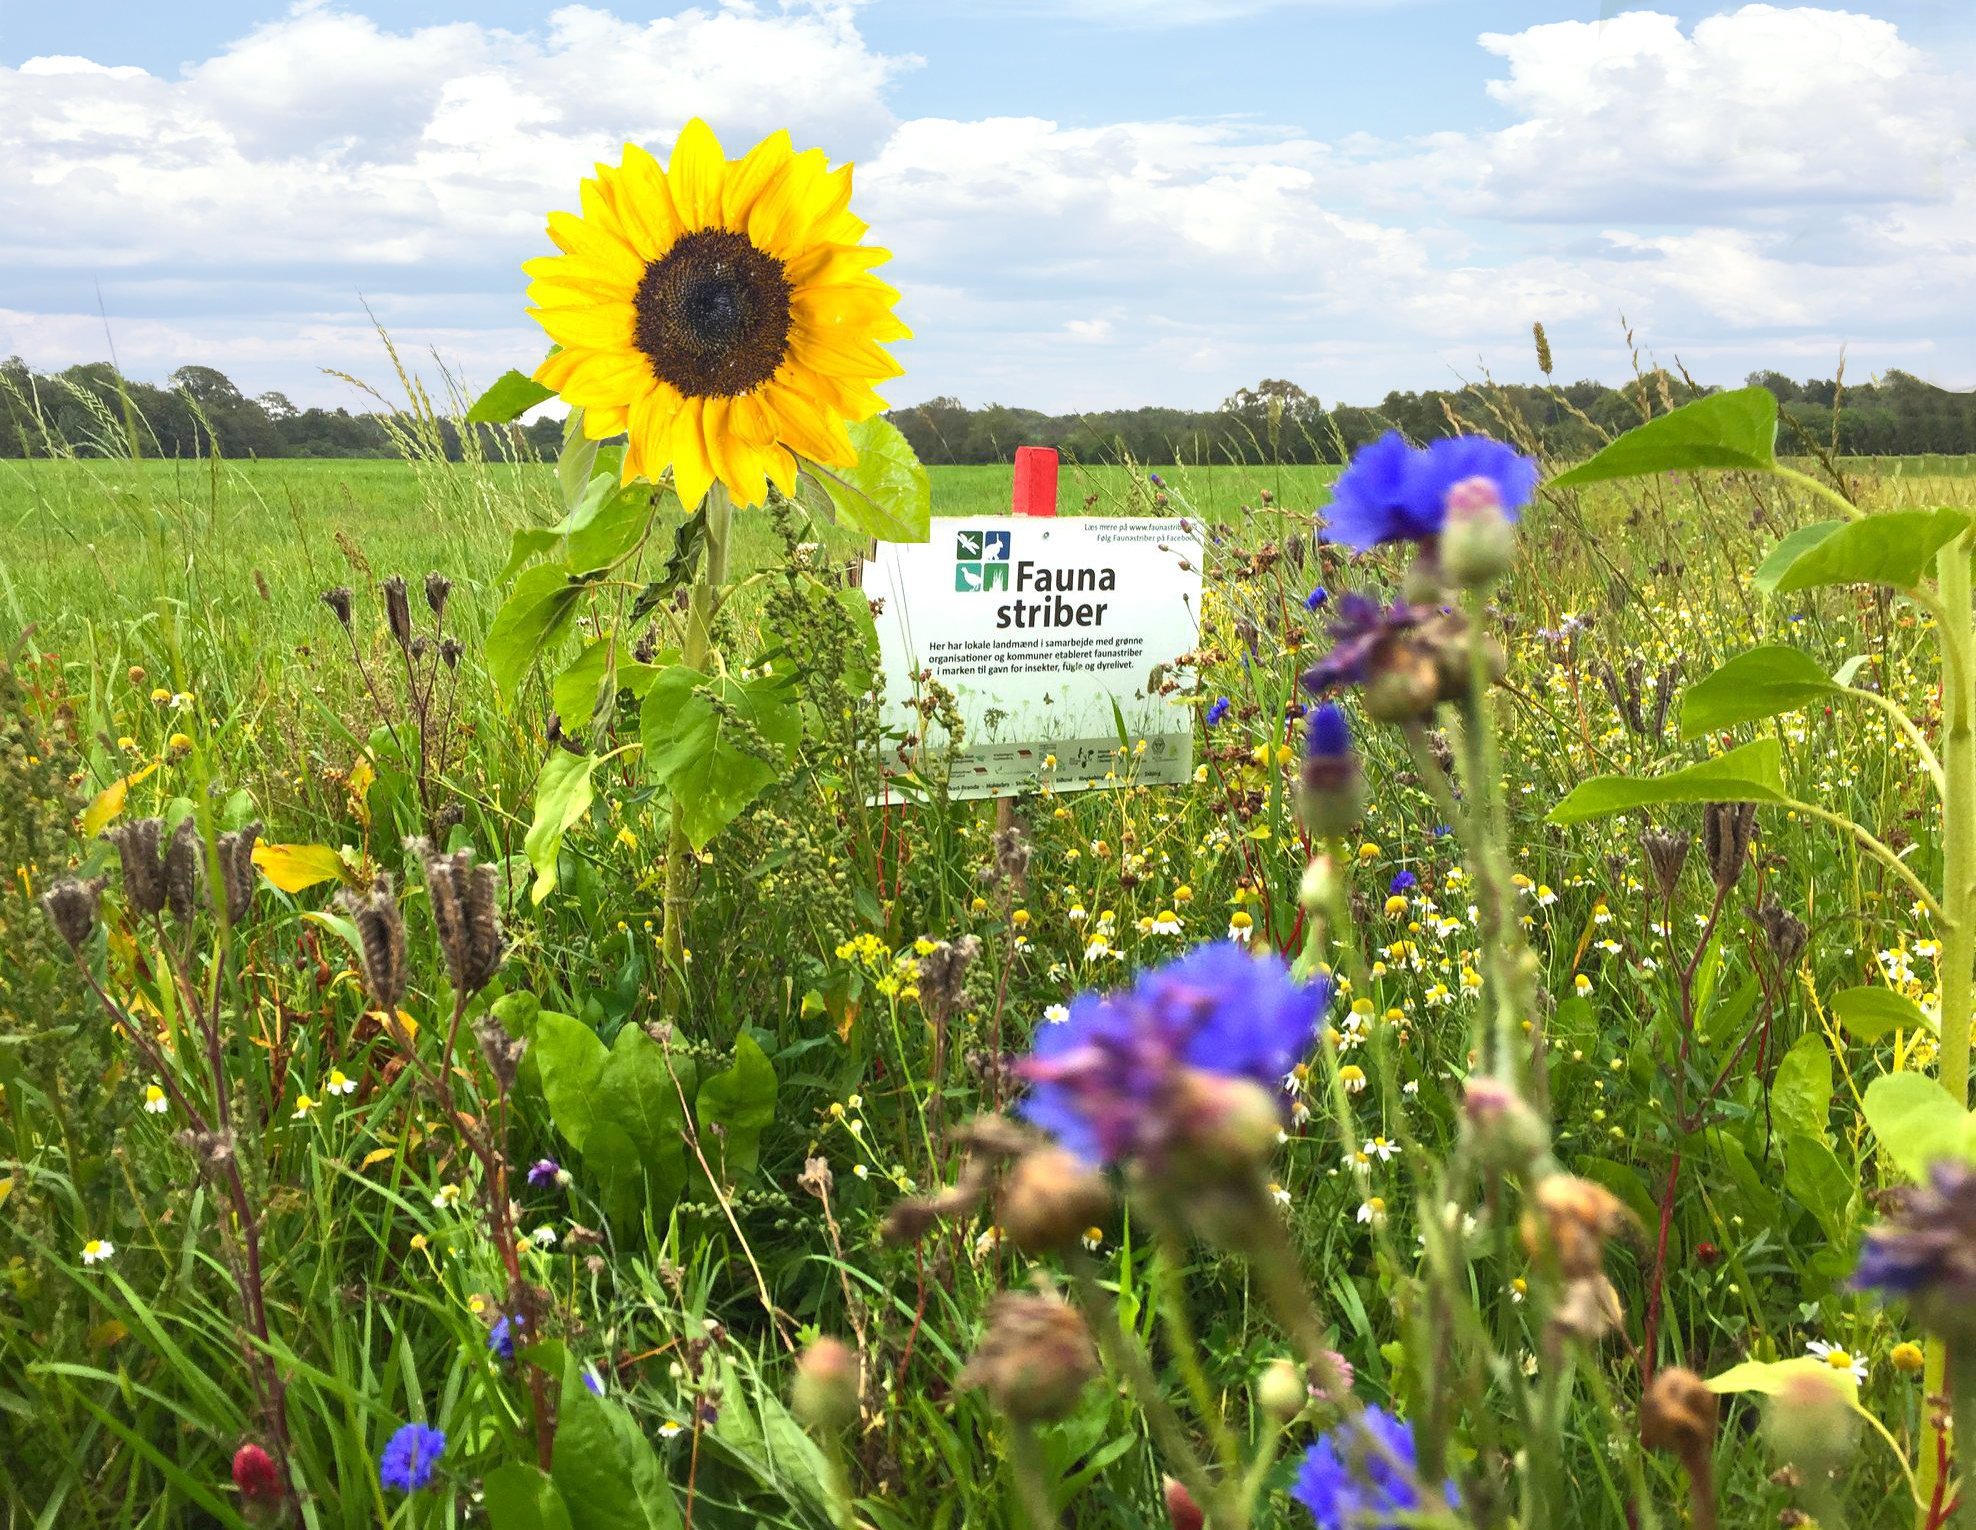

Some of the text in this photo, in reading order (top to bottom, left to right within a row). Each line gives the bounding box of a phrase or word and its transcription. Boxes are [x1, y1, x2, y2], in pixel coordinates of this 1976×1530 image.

[1084, 523, 1098, 531] Læs
[1119, 523, 1128, 532] på
[1097, 534, 1111, 543] Følg
[1113, 534, 1155, 542] Faunastriber
[1156, 534, 1165, 543] på
[1017, 561, 1116, 592] Fauna
[996, 595, 1108, 628] striber
[929, 641, 945, 651] Her
[947, 641, 962, 650] har
[964, 640, 991, 650] lokale
[992, 639, 1039, 649] landmænd
[1045, 637, 1094, 649] samarbejde
[1095, 637, 1114, 646] med
[1115, 637, 1144, 647] grønne
[928, 648, 1143, 665] organisationer og kommuner etableret faunastriber
[942, 666, 976, 676] marken
[977, 665, 986, 674] til
[988, 665, 1009, 676] gavn
[1010, 664, 1023, 673] for
[1024, 662, 1060, 673] insekter,
[1062, 661, 1083, 673] fugle
[1084, 662, 1095, 672] og
[1096, 660, 1135, 671] dyrelivet.
